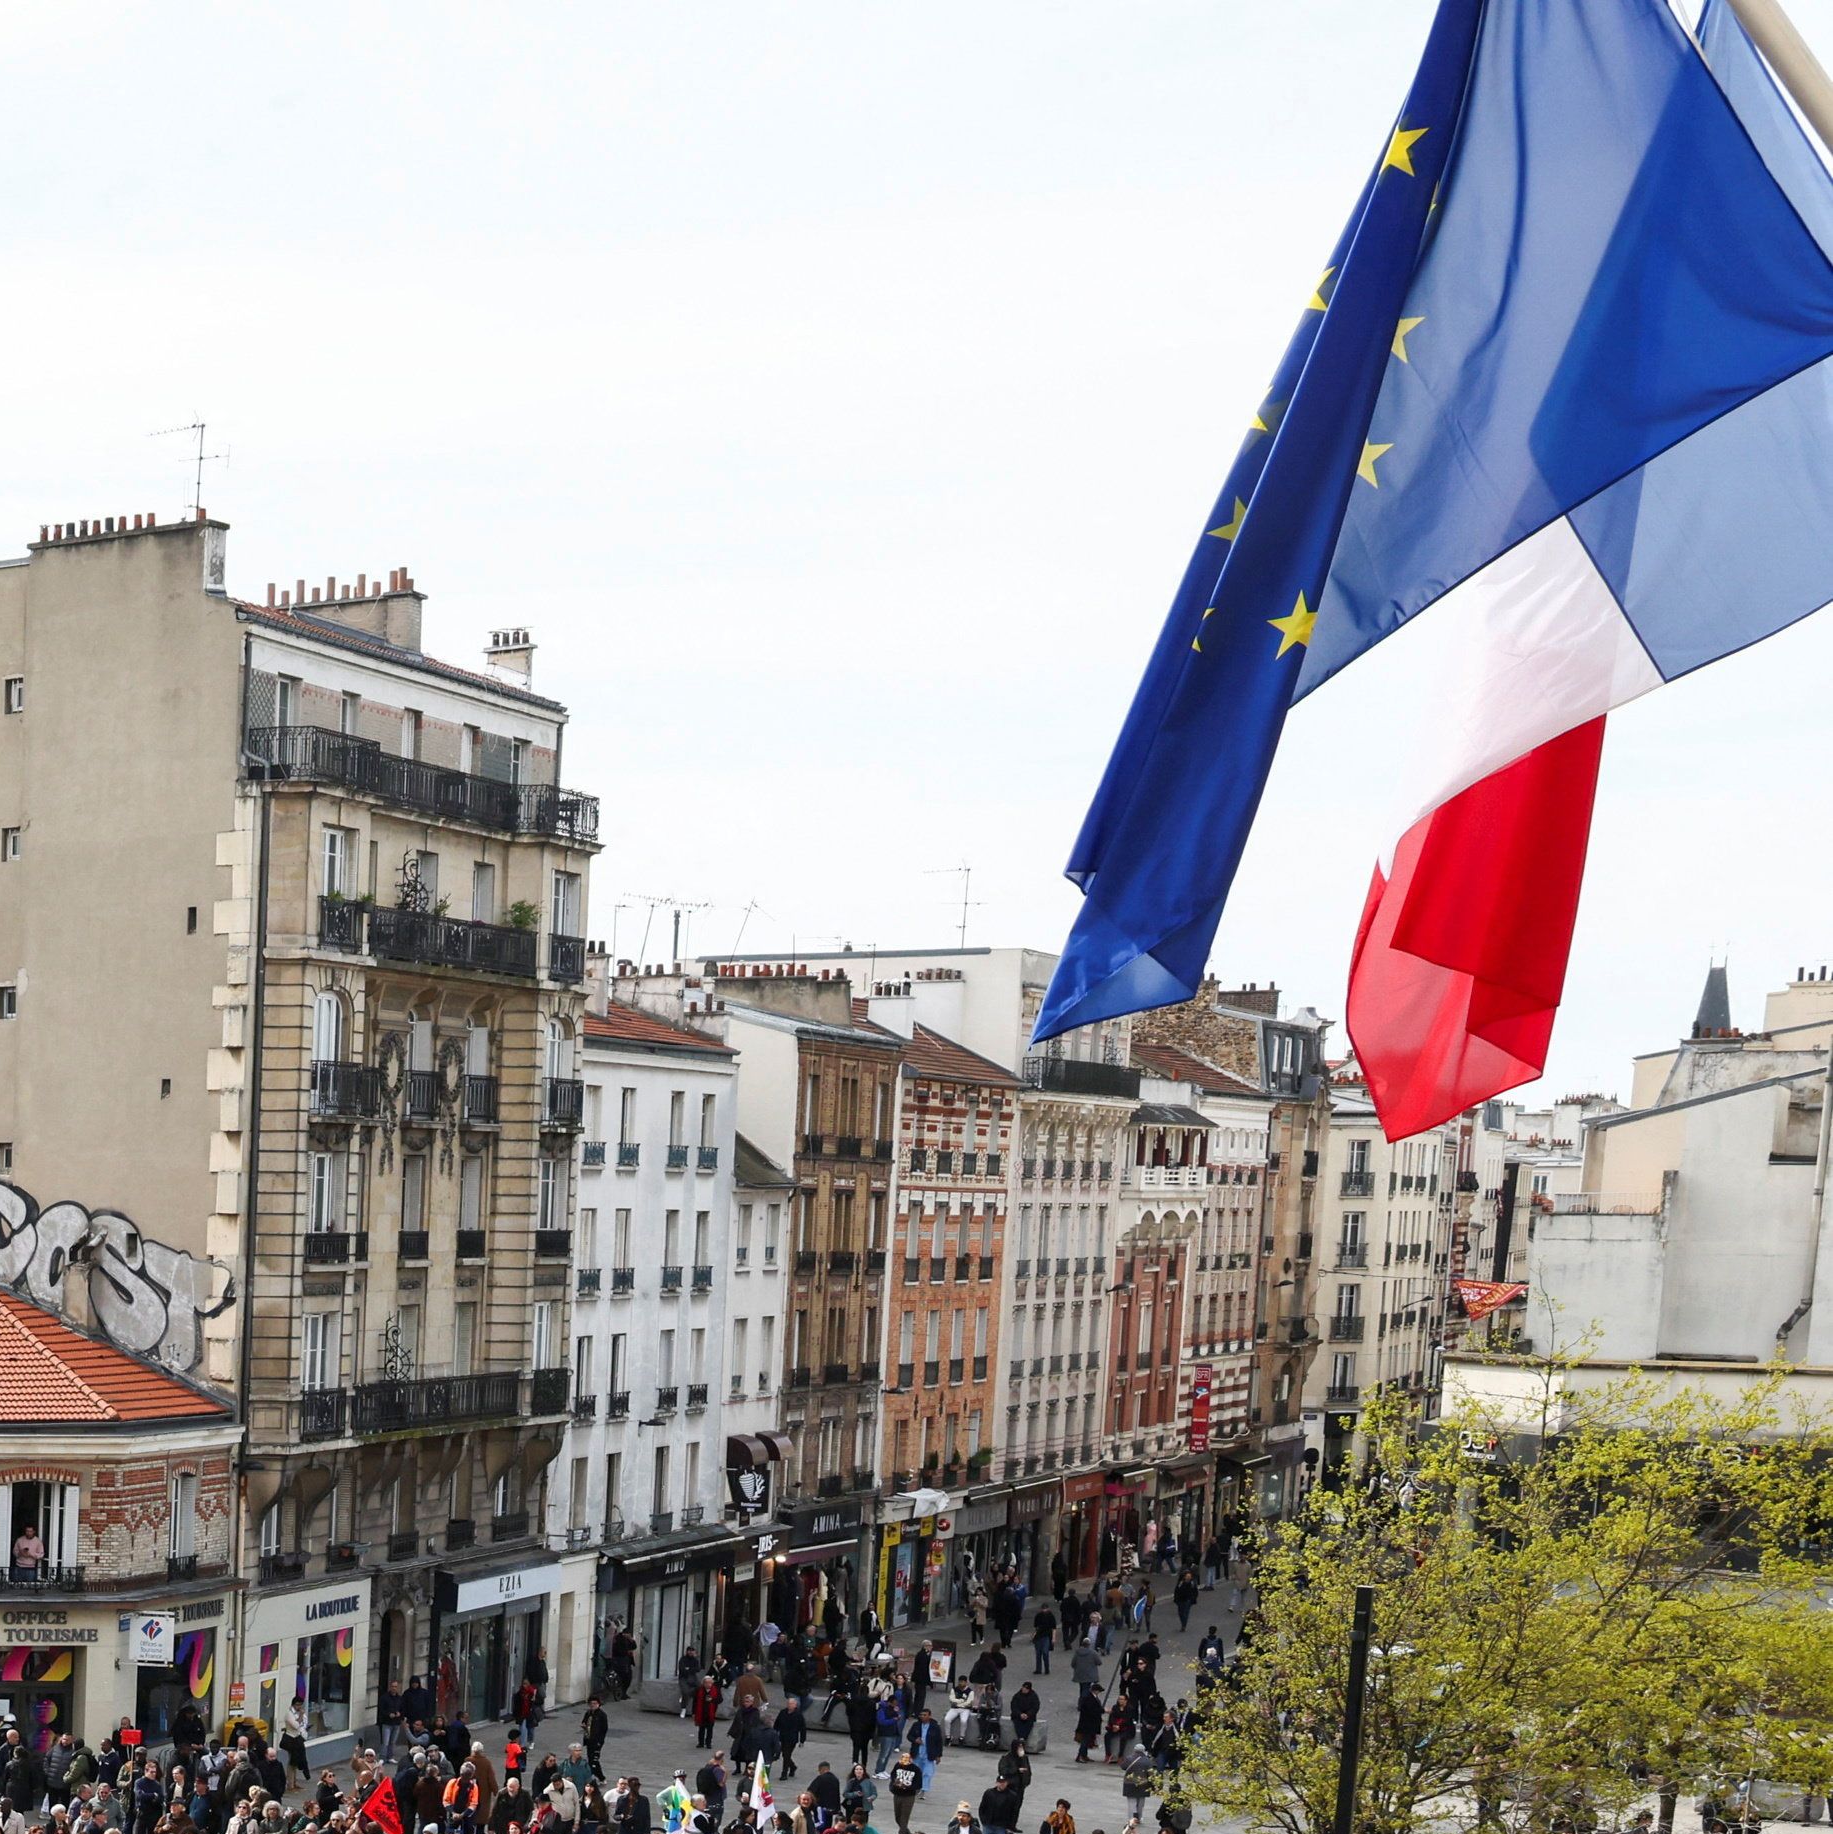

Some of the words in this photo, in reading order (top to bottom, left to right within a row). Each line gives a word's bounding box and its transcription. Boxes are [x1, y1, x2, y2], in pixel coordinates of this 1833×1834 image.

[813, 1513, 841, 1534] AMINA
[499, 1575, 521, 1593] EZIA
[306, 1603, 318, 1621] LA
[319, 1595, 360, 1618] BOUTIQUE
[3, 1610, 67, 1625] OFFICE
[4, 1627, 98, 1643] TOURISME
